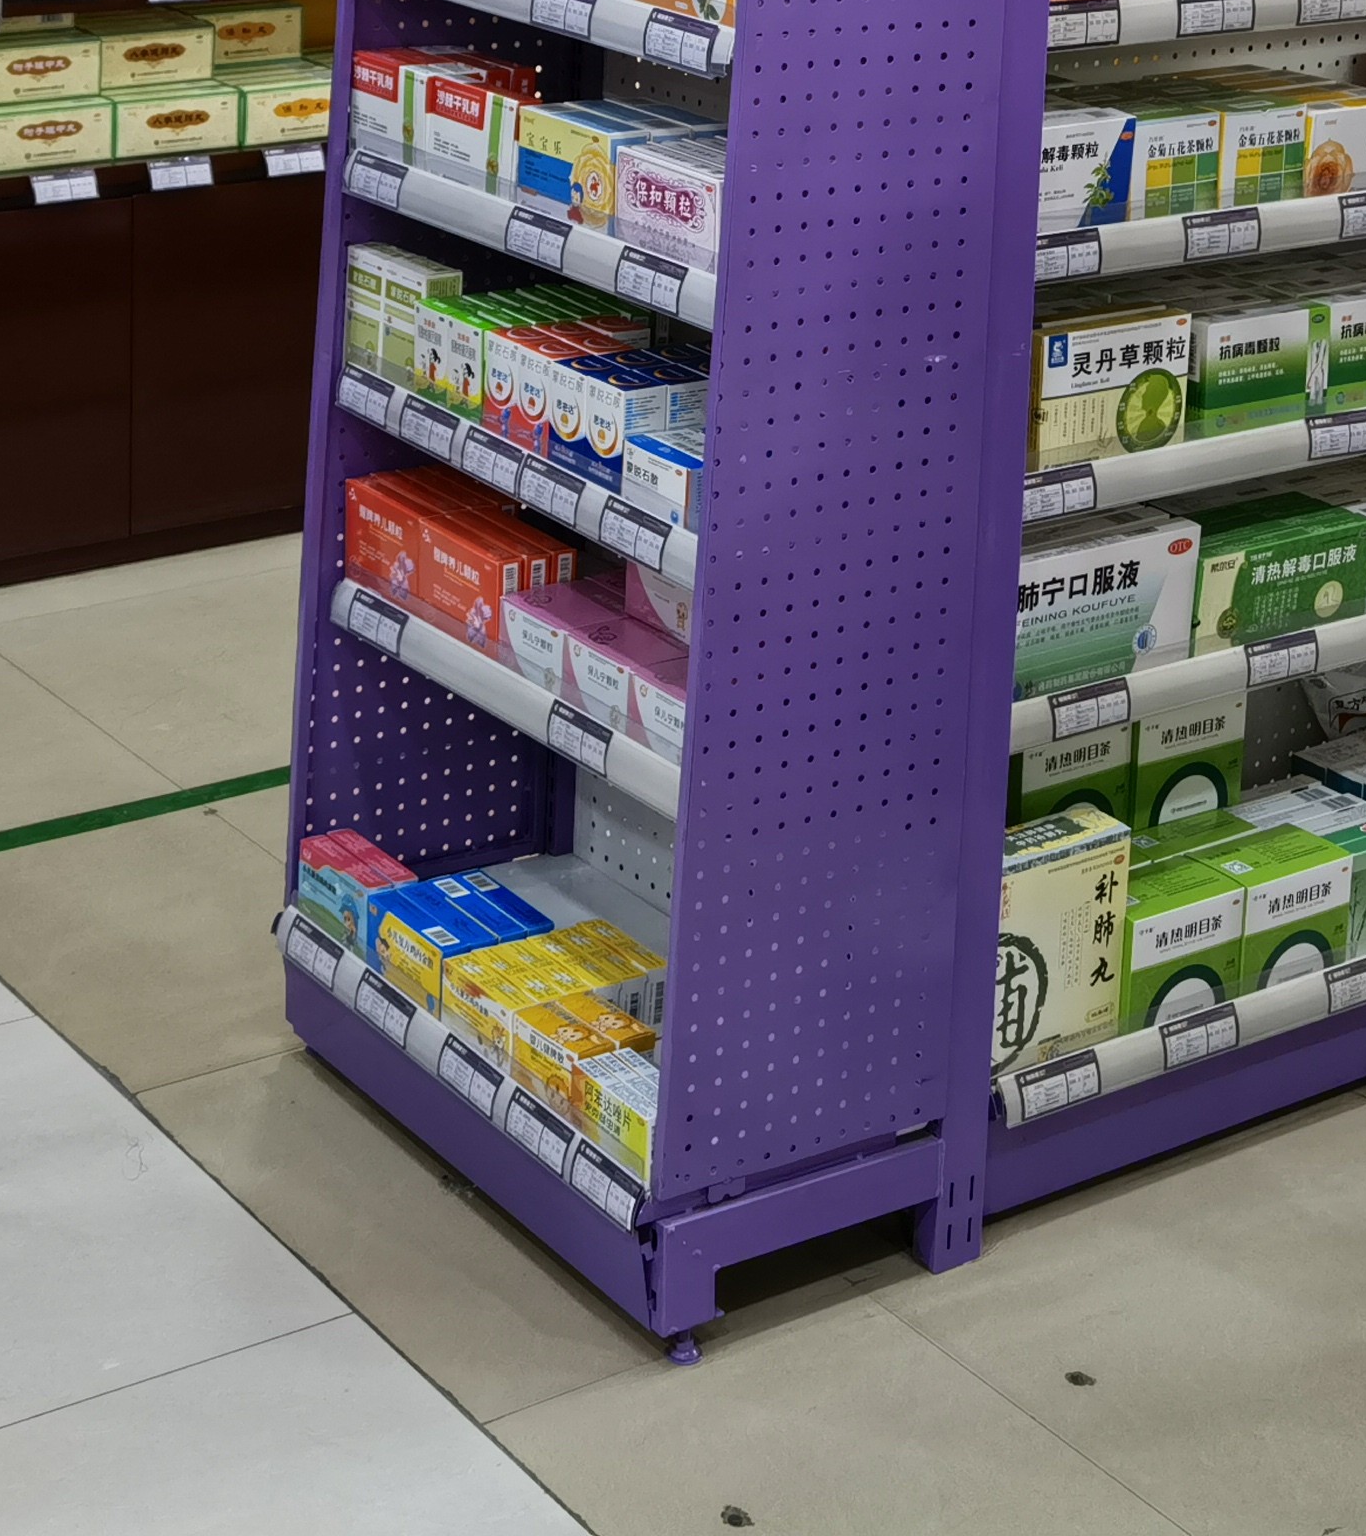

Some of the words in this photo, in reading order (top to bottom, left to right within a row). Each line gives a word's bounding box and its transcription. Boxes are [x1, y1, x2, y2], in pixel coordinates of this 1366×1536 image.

[525, 131, 563, 155] 宝宝乐
[1041, 141, 1100, 165] 解毒颗粒
[1147, 137, 1216, 159] 金菊五花茶颗粒
[1238, 127, 1302, 149] 金菊五花茶颗粒
[1071, 336, 1187, 378] 灵丹草颗粒
[1219, 336, 1280, 361] 抗病毒颗粒
[625, 460, 659, 486] 蒙脱石散
[1170, 540, 1192, 554] OTC
[1250, 542, 1357, 585] 清热解毒口服液
[1017, 560, 1141, 615] 肺宁口服液
[1072, 593, 1137, 619] KOUFUYE
[1160, 715, 1227, 747] 清热明目茶
[1044, 740, 1112, 773] 清热明目茶
[1267, 881, 1333, 915] 清热明目茶
[1089, 870, 1119, 987] 补肺丸
[1155, 914, 1223, 950] 清热明目茶
[584, 1080, 633, 1134] 阿苯达唑片
